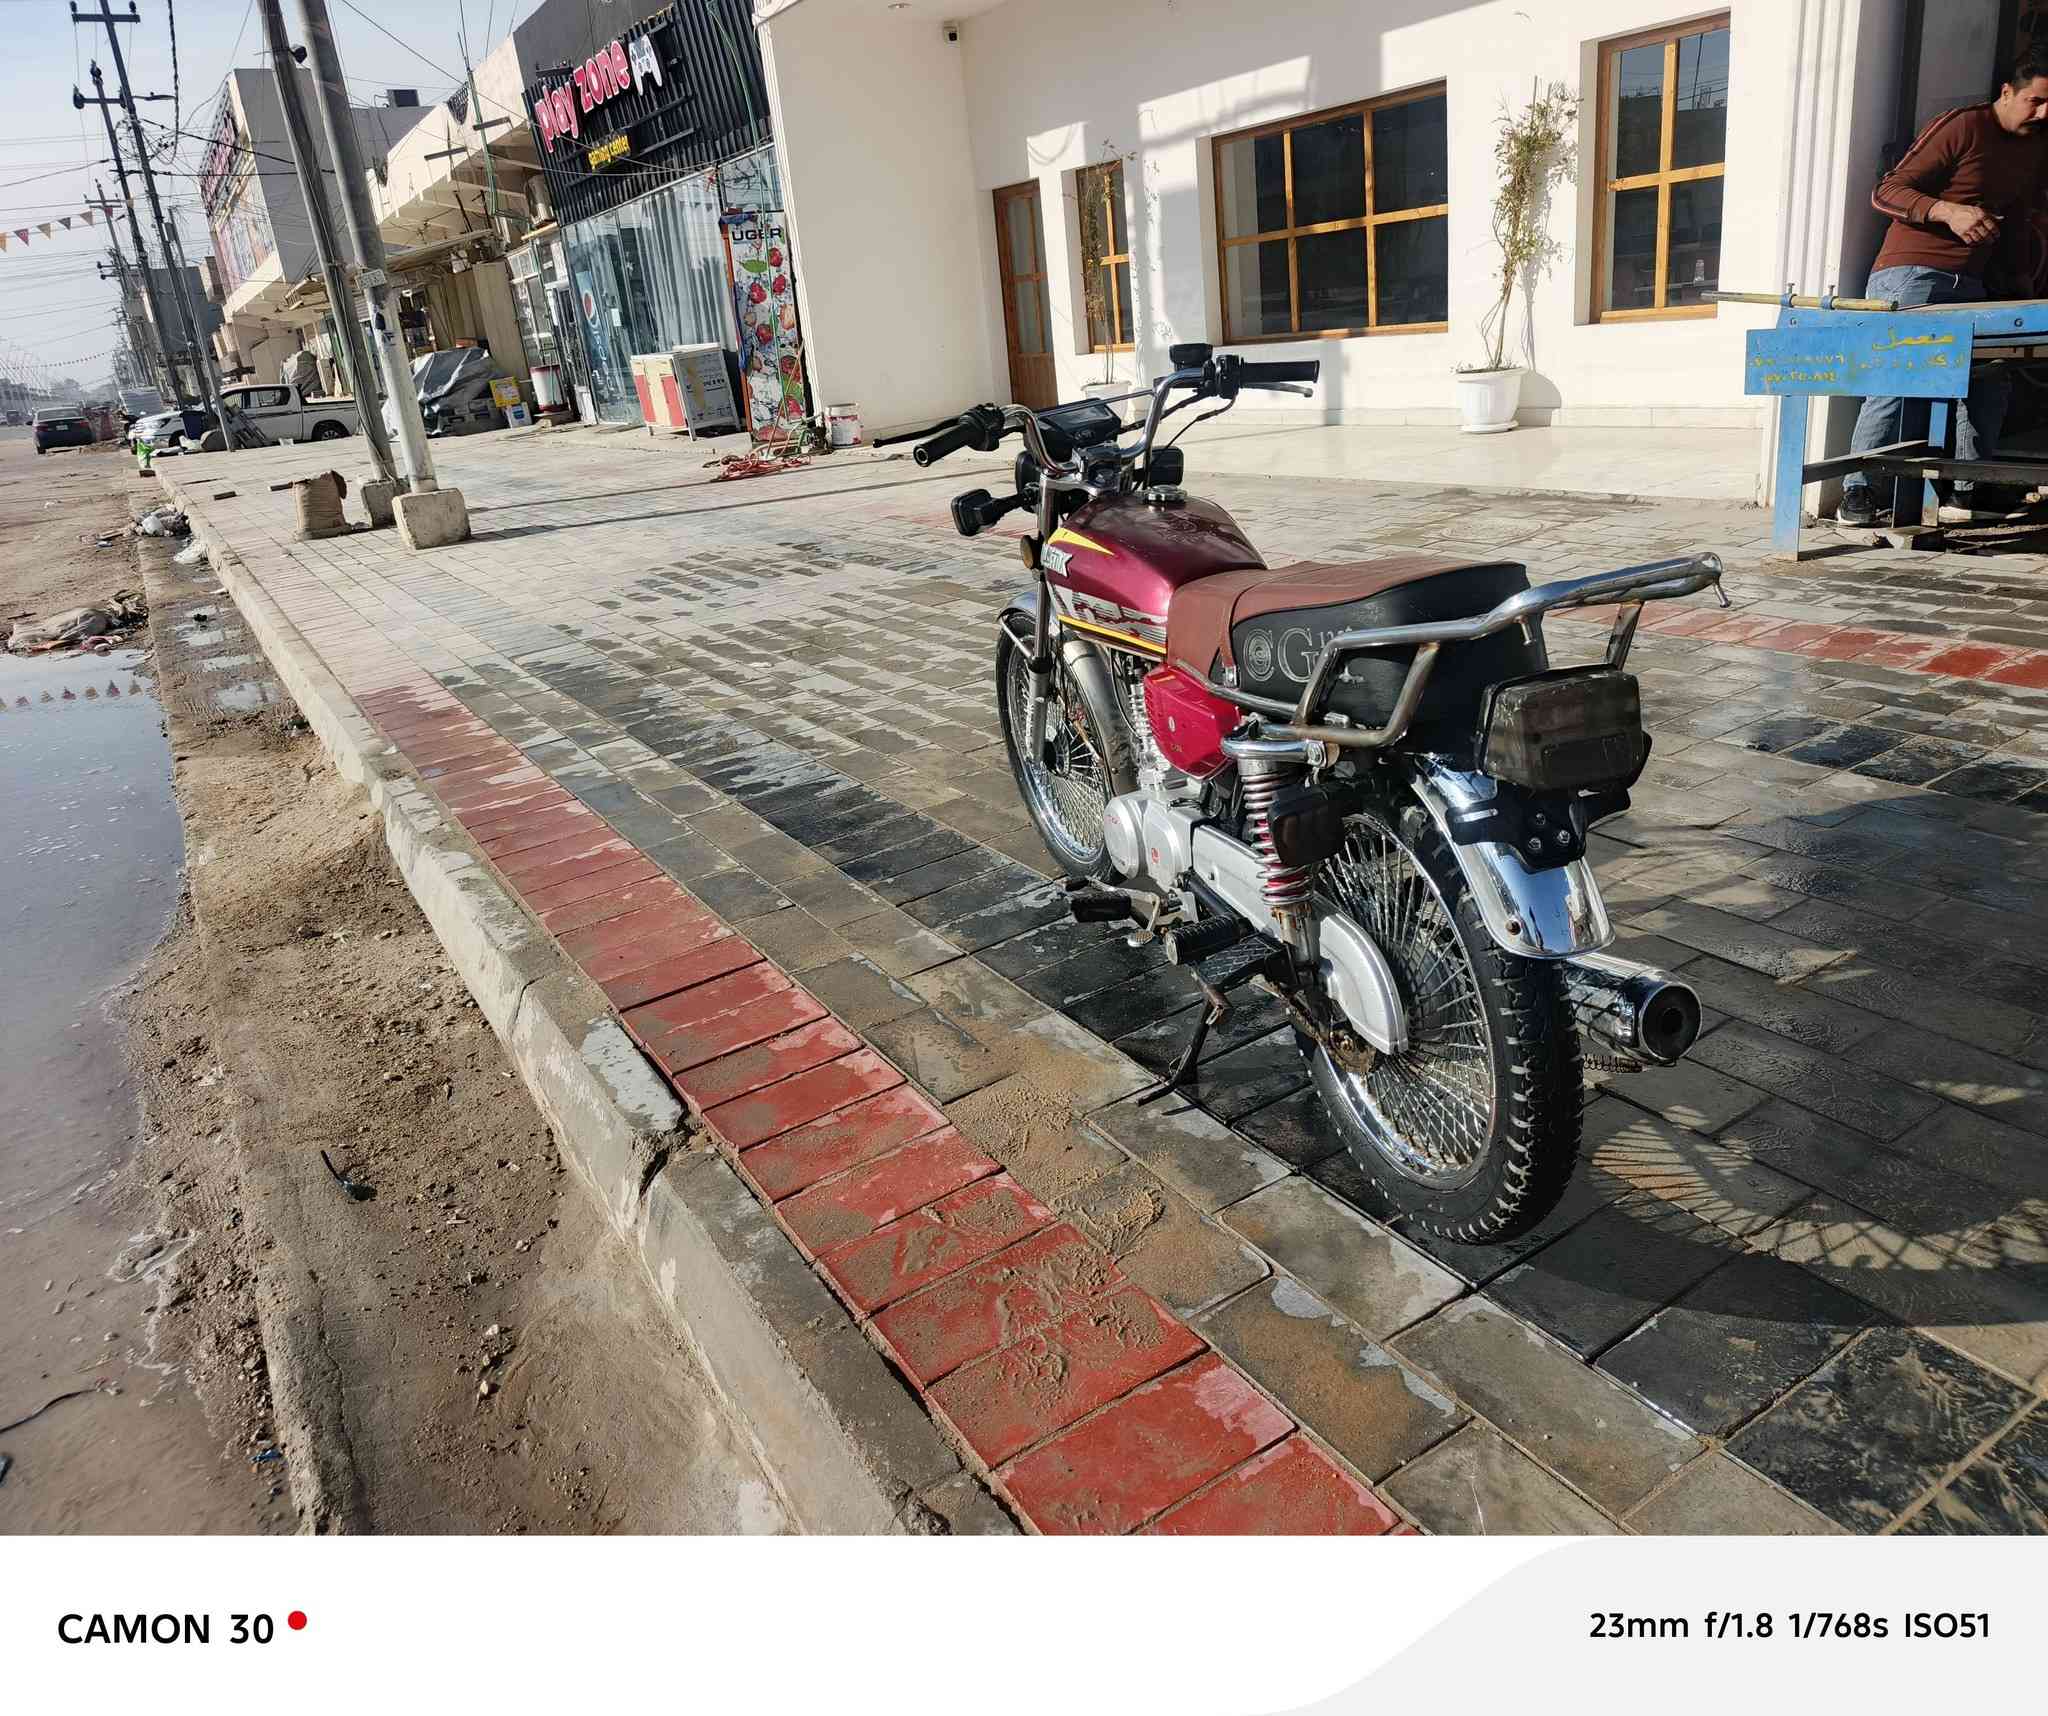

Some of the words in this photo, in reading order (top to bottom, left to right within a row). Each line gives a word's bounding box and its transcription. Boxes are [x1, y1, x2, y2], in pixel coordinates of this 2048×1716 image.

[535, 81, 579, 153] play
[573, 40, 630, 113] zone
[609, 135, 630, 157] center
